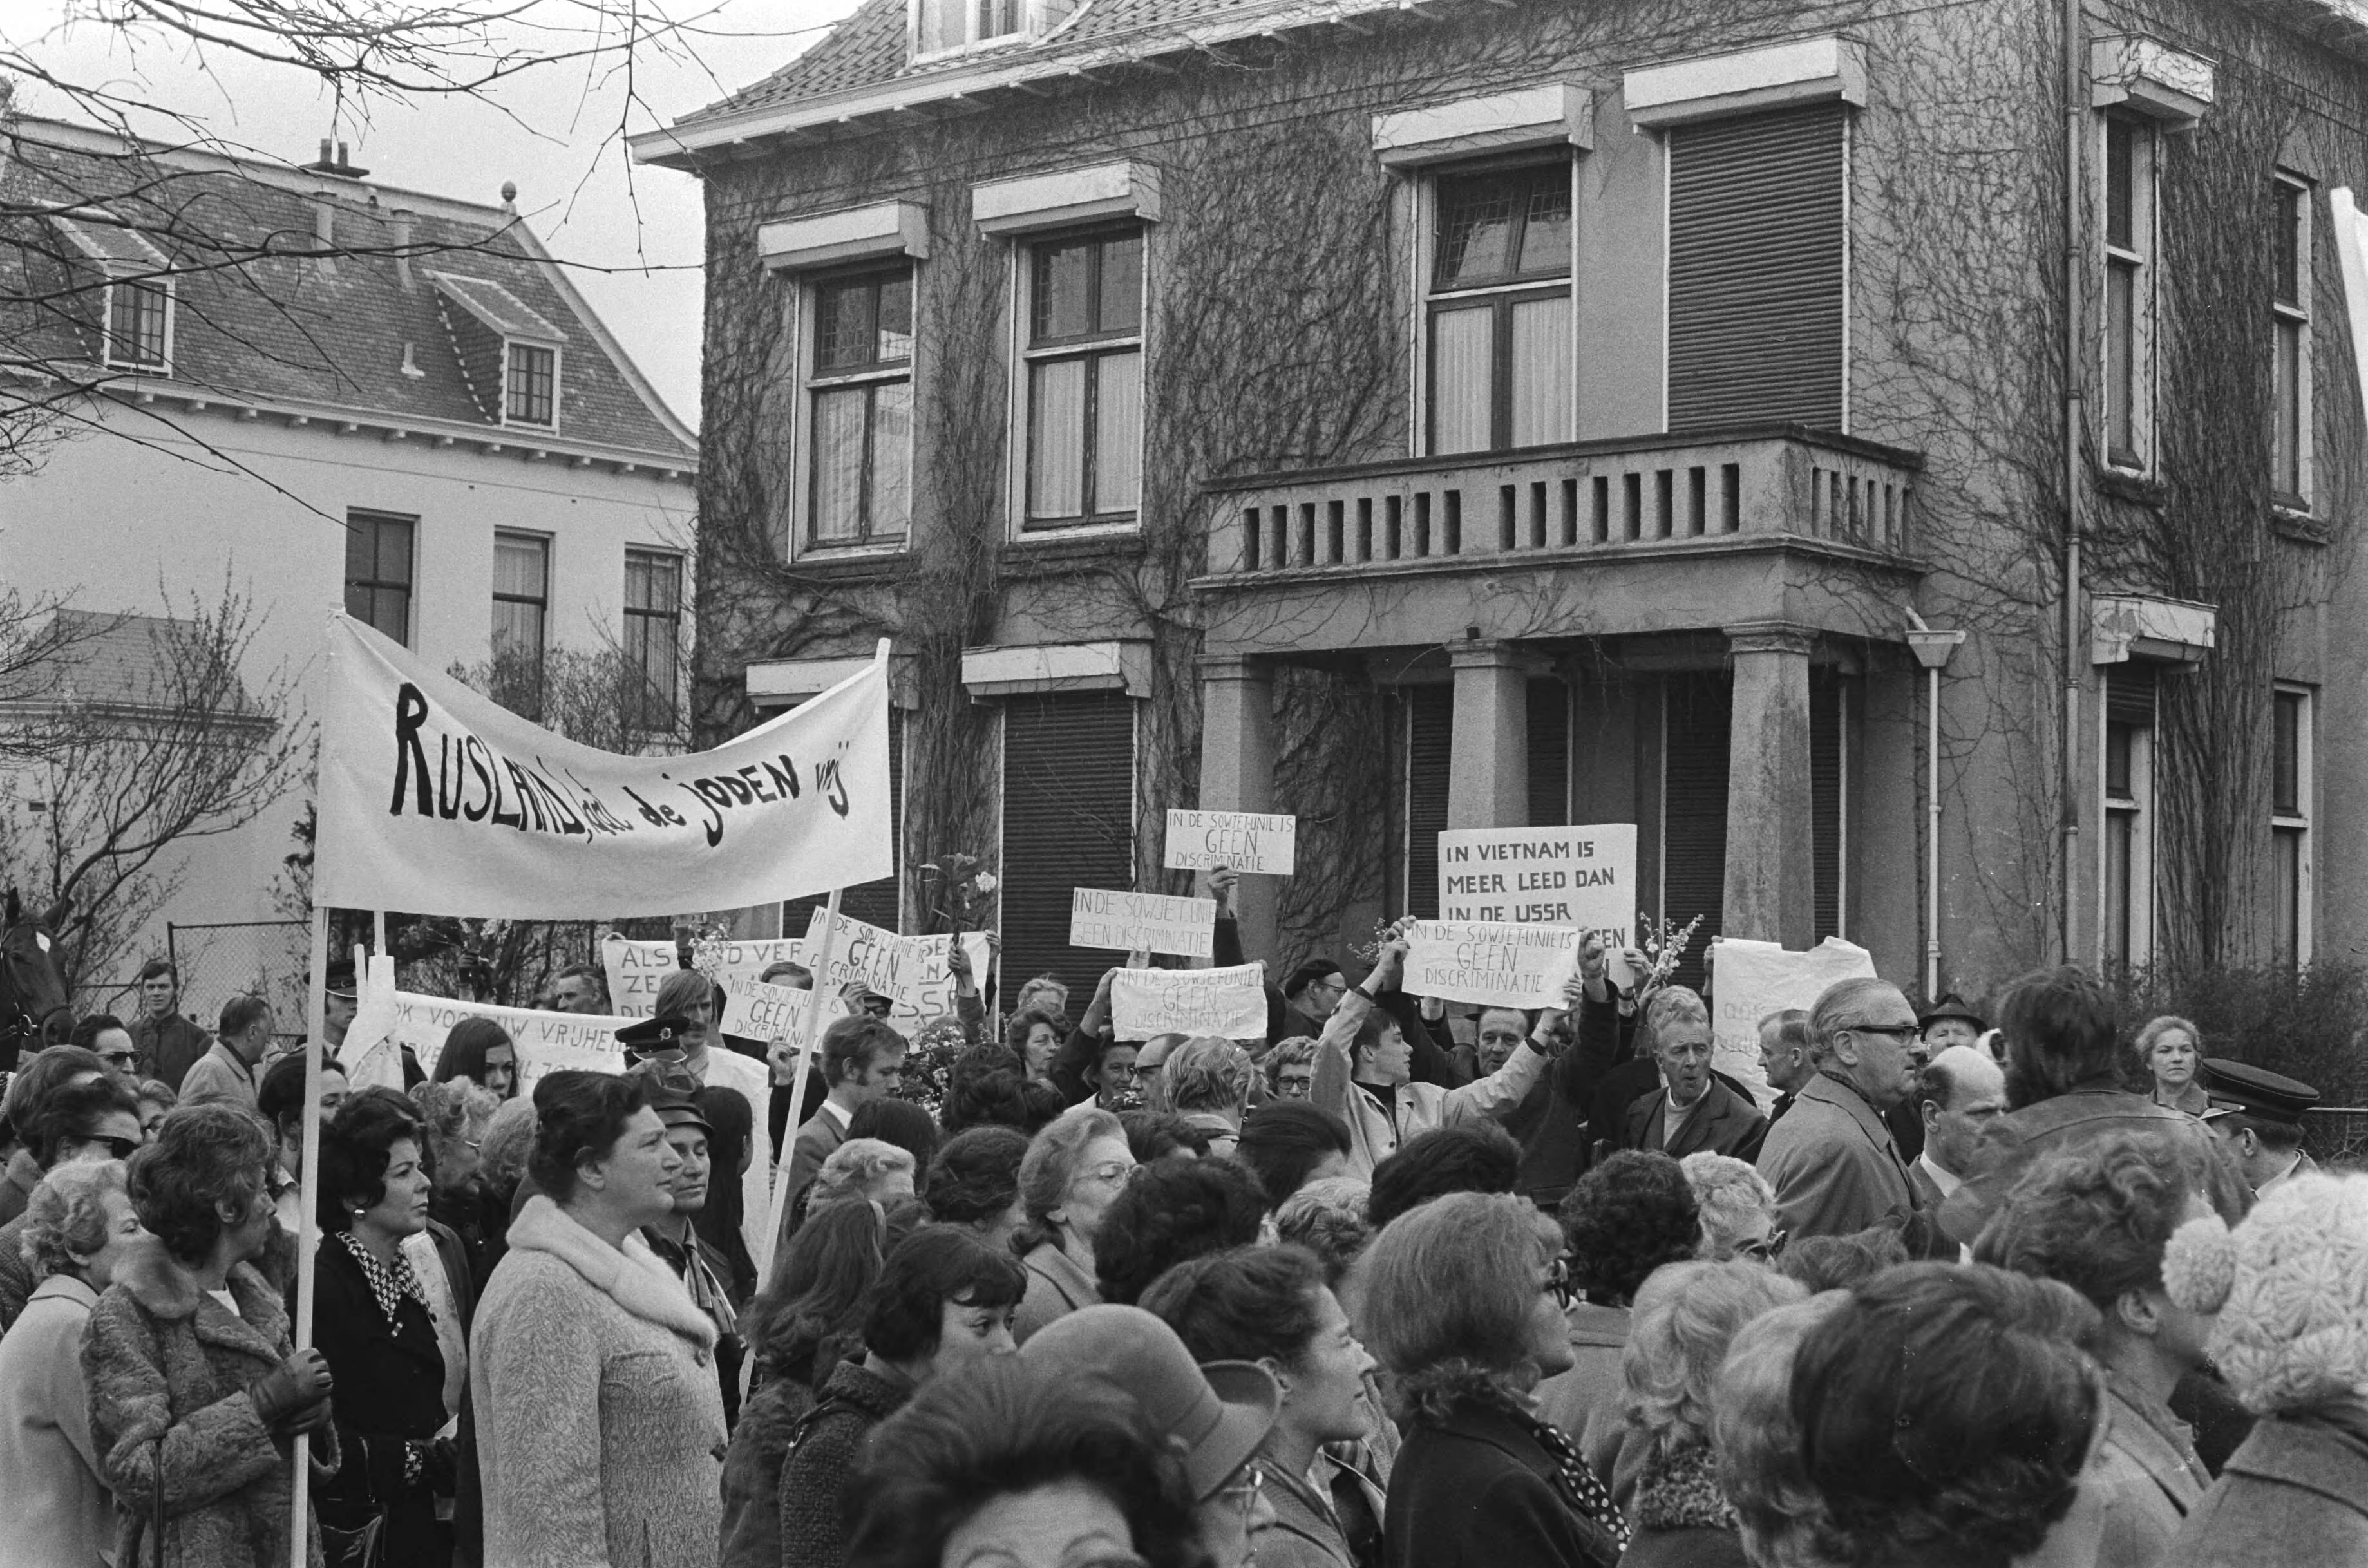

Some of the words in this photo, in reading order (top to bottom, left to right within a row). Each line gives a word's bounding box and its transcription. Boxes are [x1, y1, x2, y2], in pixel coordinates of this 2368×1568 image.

[622, 786, 687, 828] de
[815, 740, 849, 820] vrij
[1169, 812, 1183, 827] IN
[1189, 813, 1203, 828] DE
[1280, 817, 1293, 833] IS
[1205, 829, 1258, 856] GEEN
[1446, 845, 1469, 863] IN
[1477, 841, 1570, 860] VIETNAM
[1577, 840, 1594, 858] IS
[1446, 874, 1507, 894] MEER
[1517, 871, 1566, 891] LEED
[1575, 866, 1615, 888] DAN
[1074, 891, 1092, 913] IN
[1095, 892, 1115, 916] DE
[1448, 907, 1471, 921] IN
[1479, 905, 1506, 922] DE
[1515, 902, 1571, 923] USSR
[835, 917, 852, 935] DE
[1072, 921, 1113, 945] GEEN
[1411, 923, 1427, 940] IN
[1435, 925, 1454, 941] DE
[1560, 931, 1577, 949] IS
[621, 946, 670, 968] ALS
[848, 939, 901, 983] GEEN
[1457, 942, 1518, 972] GEEN
[622, 974, 659, 994] ZE
[730, 979, 743, 995] IN
[744, 982, 759, 997] DE
[1122, 970, 1139, 986] IN
[1144, 970, 1161, 986] DE
[1426, 967, 1544, 993] DISCRIMINATIE
[1162, 986, 1218, 1011] GEEN
[750, 999, 800, 1028] GEEN
